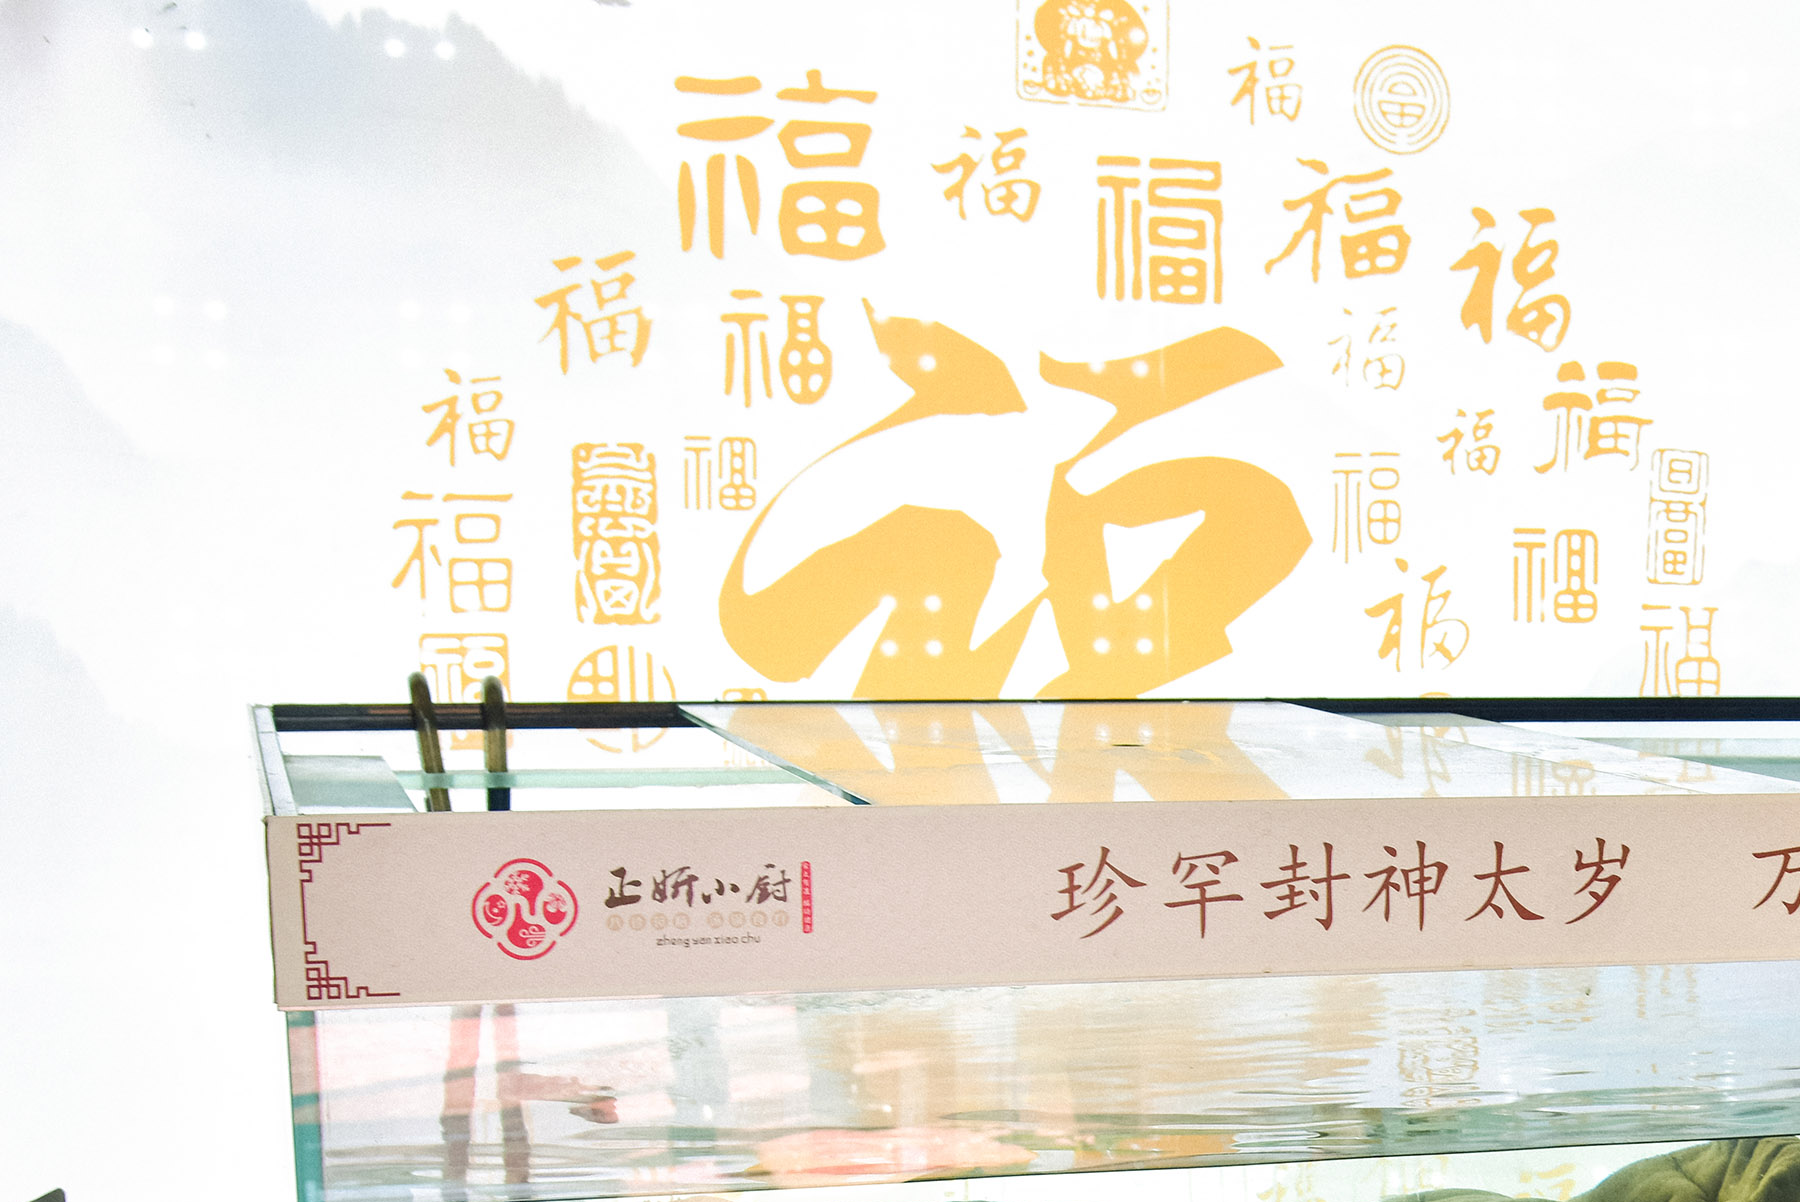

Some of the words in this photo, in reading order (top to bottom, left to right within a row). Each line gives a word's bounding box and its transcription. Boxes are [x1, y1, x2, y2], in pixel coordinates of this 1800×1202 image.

[1228, 36, 1302, 125] 福
[674, 69, 886, 261] 福
[931, 125, 1041, 222] 福
[1264, 158, 1411, 283] 福
[534, 250, 653, 375] 福
[1450, 207, 1571, 352] 福
[720, 289, 832, 408] 福
[1328, 307, 1405, 390] 福
[422, 368, 515, 466] 福
[1437, 409, 1501, 475] 福
[1534, 361, 1655, 474] 福
[392, 491, 512, 613] 福
[1333, 452, 1401, 564] 福
[1364, 558, 1470, 672] 福
[1640, 603, 1721, 697] 福
[741, 932, 761, 945] chu
[1052, 838, 1630, 938] 珍罕封神太岁
